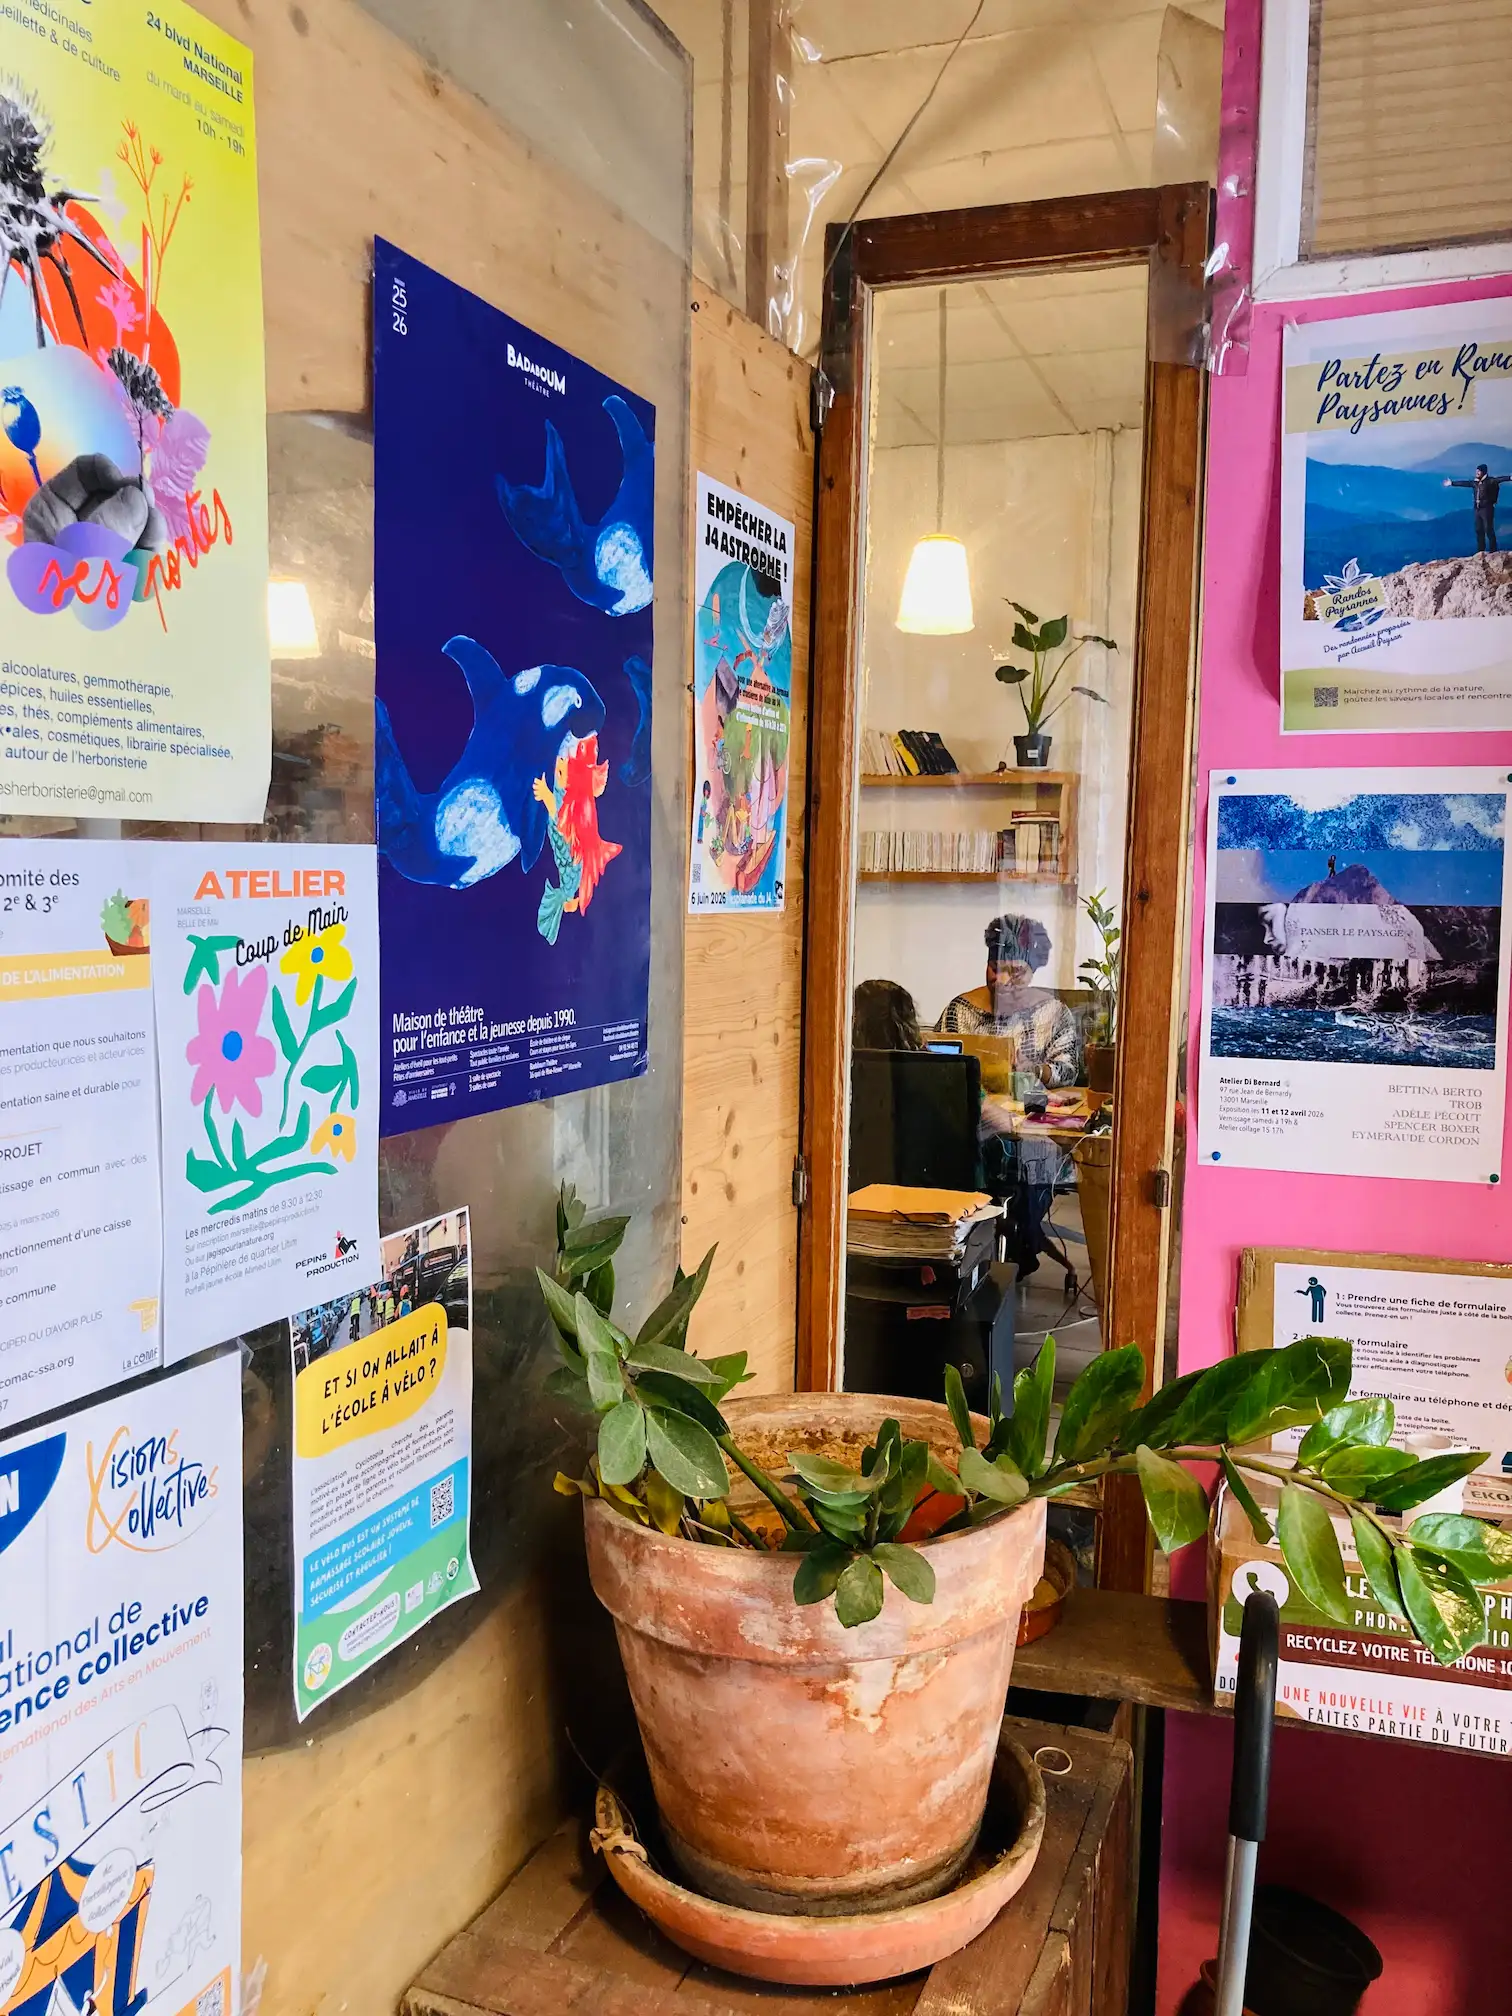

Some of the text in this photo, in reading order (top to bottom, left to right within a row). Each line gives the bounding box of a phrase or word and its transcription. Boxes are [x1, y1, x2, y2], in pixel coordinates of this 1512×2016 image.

[50, 28, 120, 82] & de culture
[146, 12, 243, 85] 24 blvd National
[183, 57, 243, 104] MARSEILLE
[146, 70, 244, 138] du mardi samedi
[197, 119, 245, 157] 10h 19h
[1317, 353, 1444, 392] Partez en
[524, 377, 550, 398] THÉÂTRE
[1317, 392, 1455, 435] Paysannes
[707, 492, 786, 554] EMPÊCHER LA
[38, 559, 123, 610] ses
[1332, 586, 1371, 605] Randos
[1325, 595, 1378, 618] Paysannes
[1339, 620, 1411, 649] randonnées proposées
[1377, 633, 1402, 649] Paysan
[2, 660, 174, 699] alcoolatures, gemmothérapie,
[0, 682, 155, 715] épices, huiles essentielles,
[1395, 687, 1428, 696] rythme
[23, 705, 205, 739] thés, compléments alimentaires,
[47, 730, 234, 760] cosmétiques, librairie spécialisée,
[5, 747, 147, 770] autour de l'herboristerie
[50, 869, 80, 886] des
[194, 870, 345, 900] ATELIER
[25, 894, 37, 911] &
[697, 892, 727, 905] juin 2026
[177, 907, 212, 915] MARSEILLE
[236, 901, 348, 966] Coup de Main
[1300, 928, 1404, 938] PANSER LE PAYSAGE
[2, 964, 125, 985] DE L'ALIMENTATION
[393, 1005, 484, 1033] Maison de théâtre
[52, 1030, 146, 1052] que nous souhaitons
[393, 1008, 576, 1058] pour l'enfance et la jeunesse depuis 1990.
[44, 1082, 119, 1102] saine durable
[1220, 1077, 1242, 1085] Atelier
[1388, 1084, 1482, 1098] BETTINA BERTO
[1392, 1108, 1482, 1122] ADÈLE PÉCOUT
[1449, 1100, 1482, 1110] TROB
[1351, 1131, 1480, 1146] EYMERAUDE CORDON
[1384, 1120, 1481, 1134] SPENCER BOXER
[40, 1164, 100, 1184] en commun
[75, 1218, 132, 1241] d'une caisse
[186, 1207, 268, 1240] Les mercredis matins
[200, 1244, 279, 1276] Pépinière quartier
[295, 1253, 327, 1270] PEPINS
[306, 1254, 359, 1278] PRODUCTION
[5, 1283, 56, 1305] commune
[1347, 1293, 1387, 1304] Prendre
[1411, 1297, 1435, 1307] fiche
[1438, 1299, 1451, 1308] de
[1453, 1300, 1506, 1312] formulaire
[1365, 1312, 1398, 1320] Prenez-en
[1401, 1306, 1438, 1315] formulaires
[1357, 1338, 1408, 1349] formulaire
[324, 1323, 438, 1399] ET SI ON ALLAIT À
[1401, 1350, 1480, 1363] identifier problèmes
[1411, 1360, 1457, 1370] diagnostiquer
[322, 1358, 436, 1435] L'ÉCOLE À VÉLO ?
[1360, 1390, 1411, 1402] formulaire
[1429, 1395, 1479, 1408] téléphone
[1482, 1401, 1493, 1410] et
[1404, 1423, 1437, 1431] téléphone
[310, 1560, 319, 1573] LE
[357, 1529, 368, 1543] EST
[108, 1601, 142, 1634] de
[77, 1595, 209, 1686] collective
[1287, 1634, 1409, 1662] RECYCLEZ VOTRE
[101, 1627, 212, 1702] Arts Mouvement
[1283, 1685, 1501, 1734] UNE NOUVELLE VIE VOTRE
[1308, 1707, 1508, 1753] FAITES PARTIE DU FUTUR
